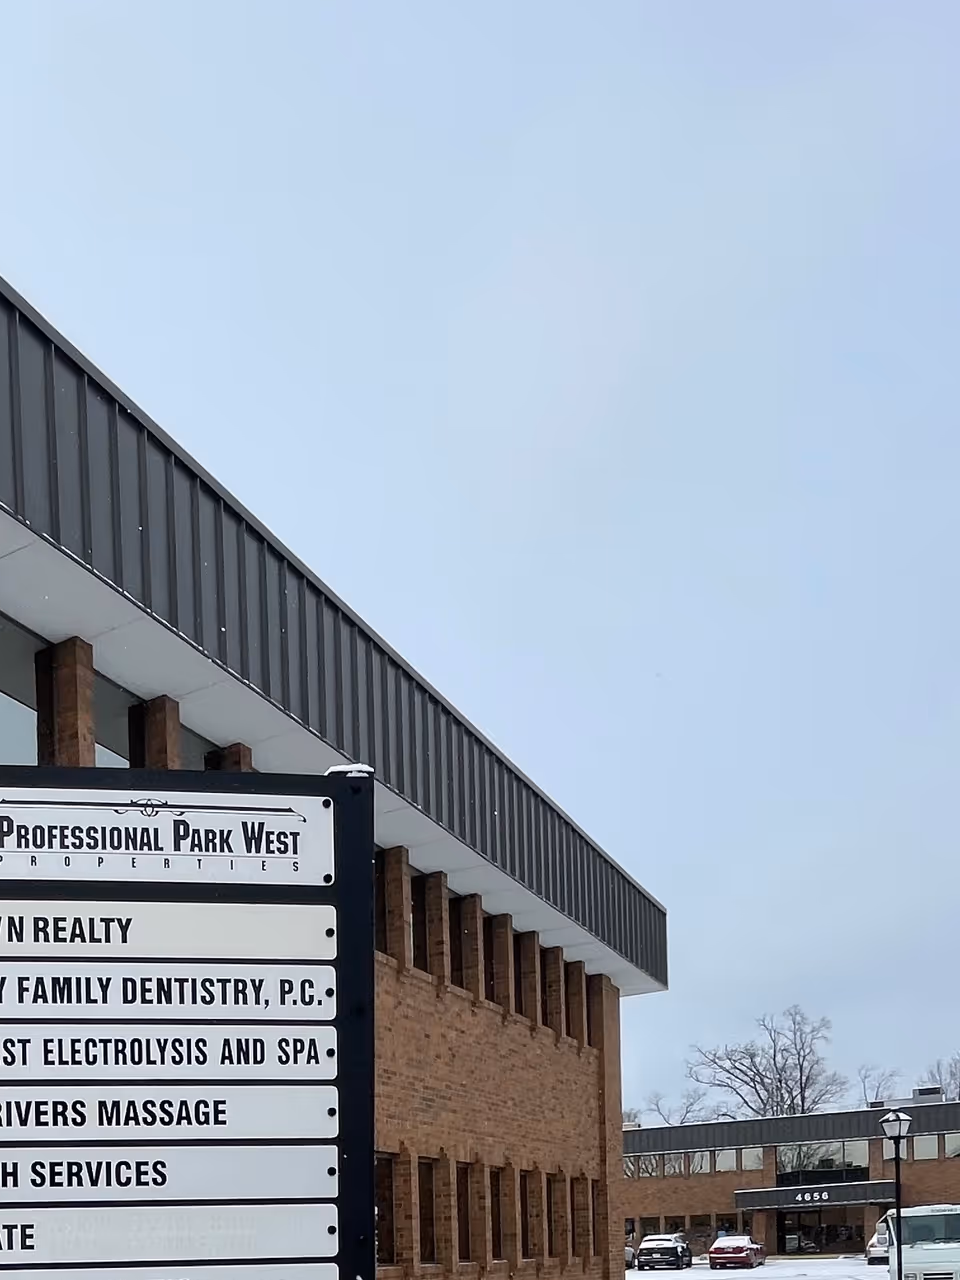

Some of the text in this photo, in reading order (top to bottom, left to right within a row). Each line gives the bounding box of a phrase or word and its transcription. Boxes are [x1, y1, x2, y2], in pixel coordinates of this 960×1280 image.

[34, 917, 132, 943] REALTY
[18, 977, 111, 1004] FAMILY
[123, 977, 269, 1009] DENTISTRY,
[280, 979, 324, 1005] P.C.
[44, 1038, 207, 1065] ELECTROLYSIS
[221, 1039, 264, 1065] AND
[278, 1038, 319, 1065] SPA
[98, 1100, 226, 1126] MASSAGE
[31, 1161, 166, 1187] SERVICES
[795, 1191, 829, 1202] 4656
